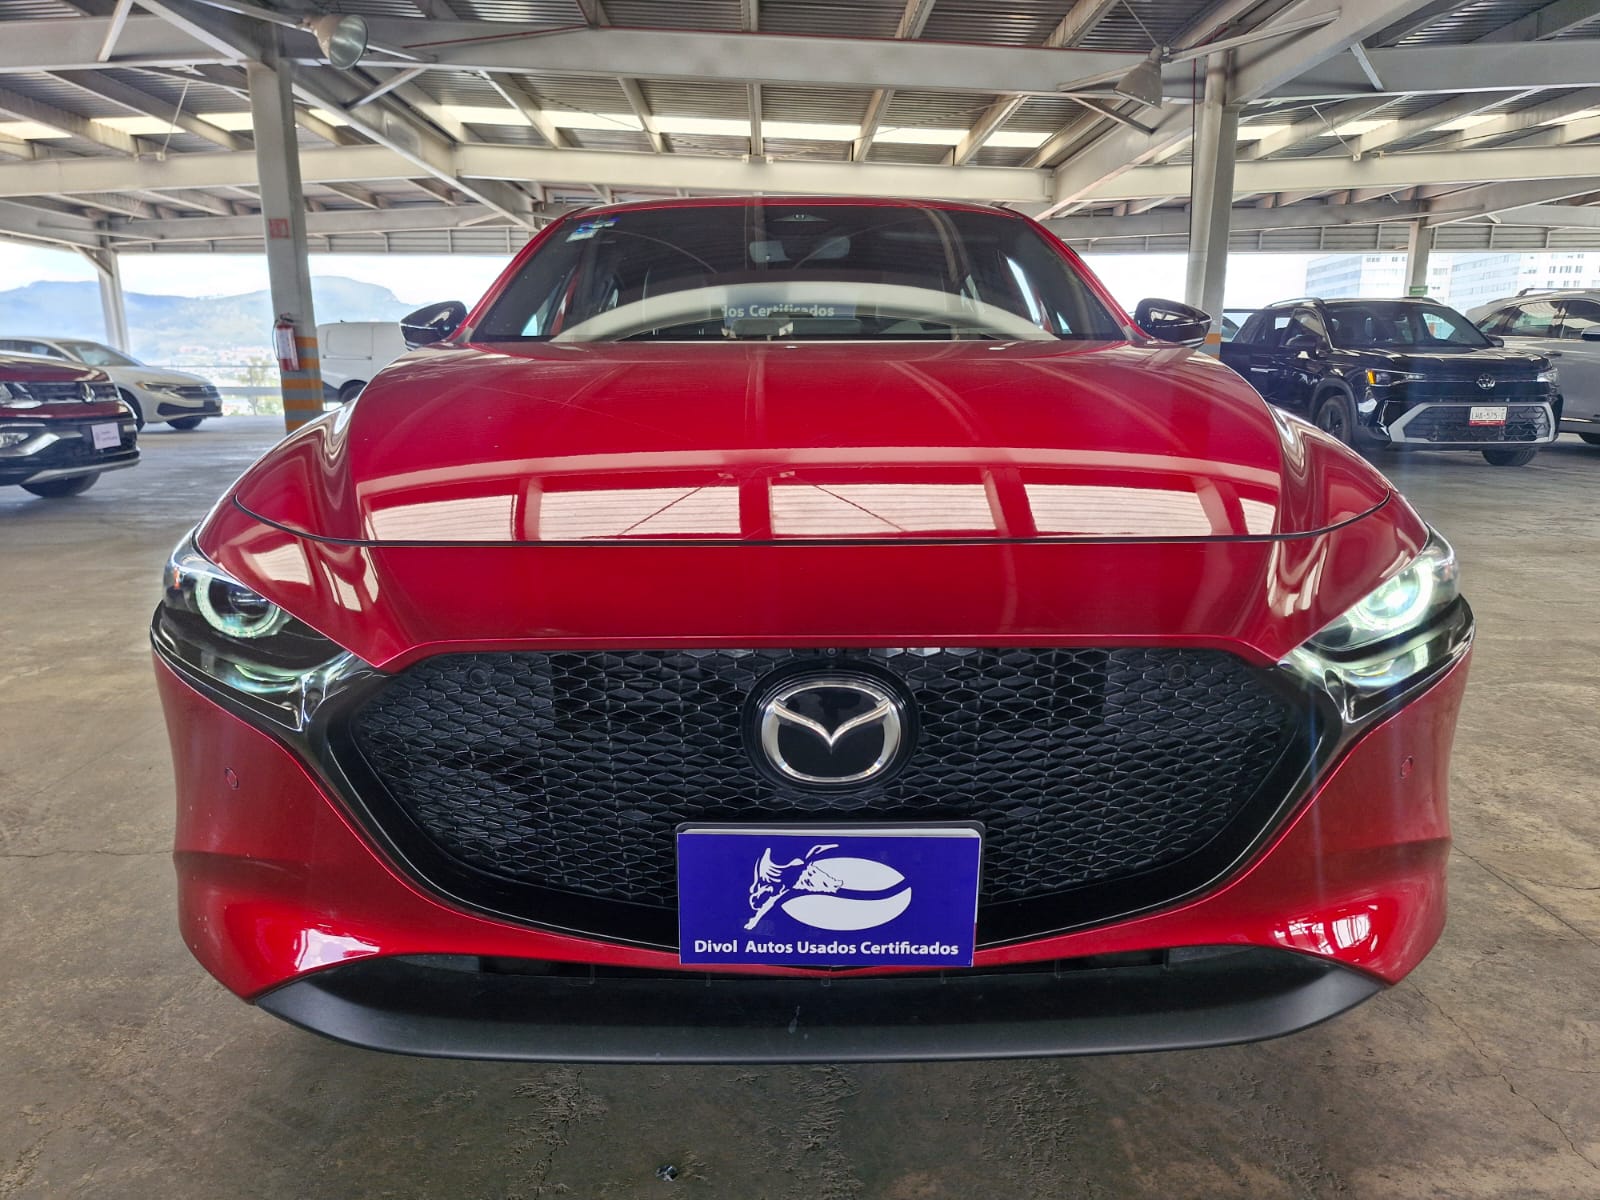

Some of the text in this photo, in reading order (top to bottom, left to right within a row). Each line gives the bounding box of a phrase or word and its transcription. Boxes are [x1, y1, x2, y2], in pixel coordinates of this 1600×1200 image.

[694, 940, 959, 955] Divol Autos Usados Certificados
